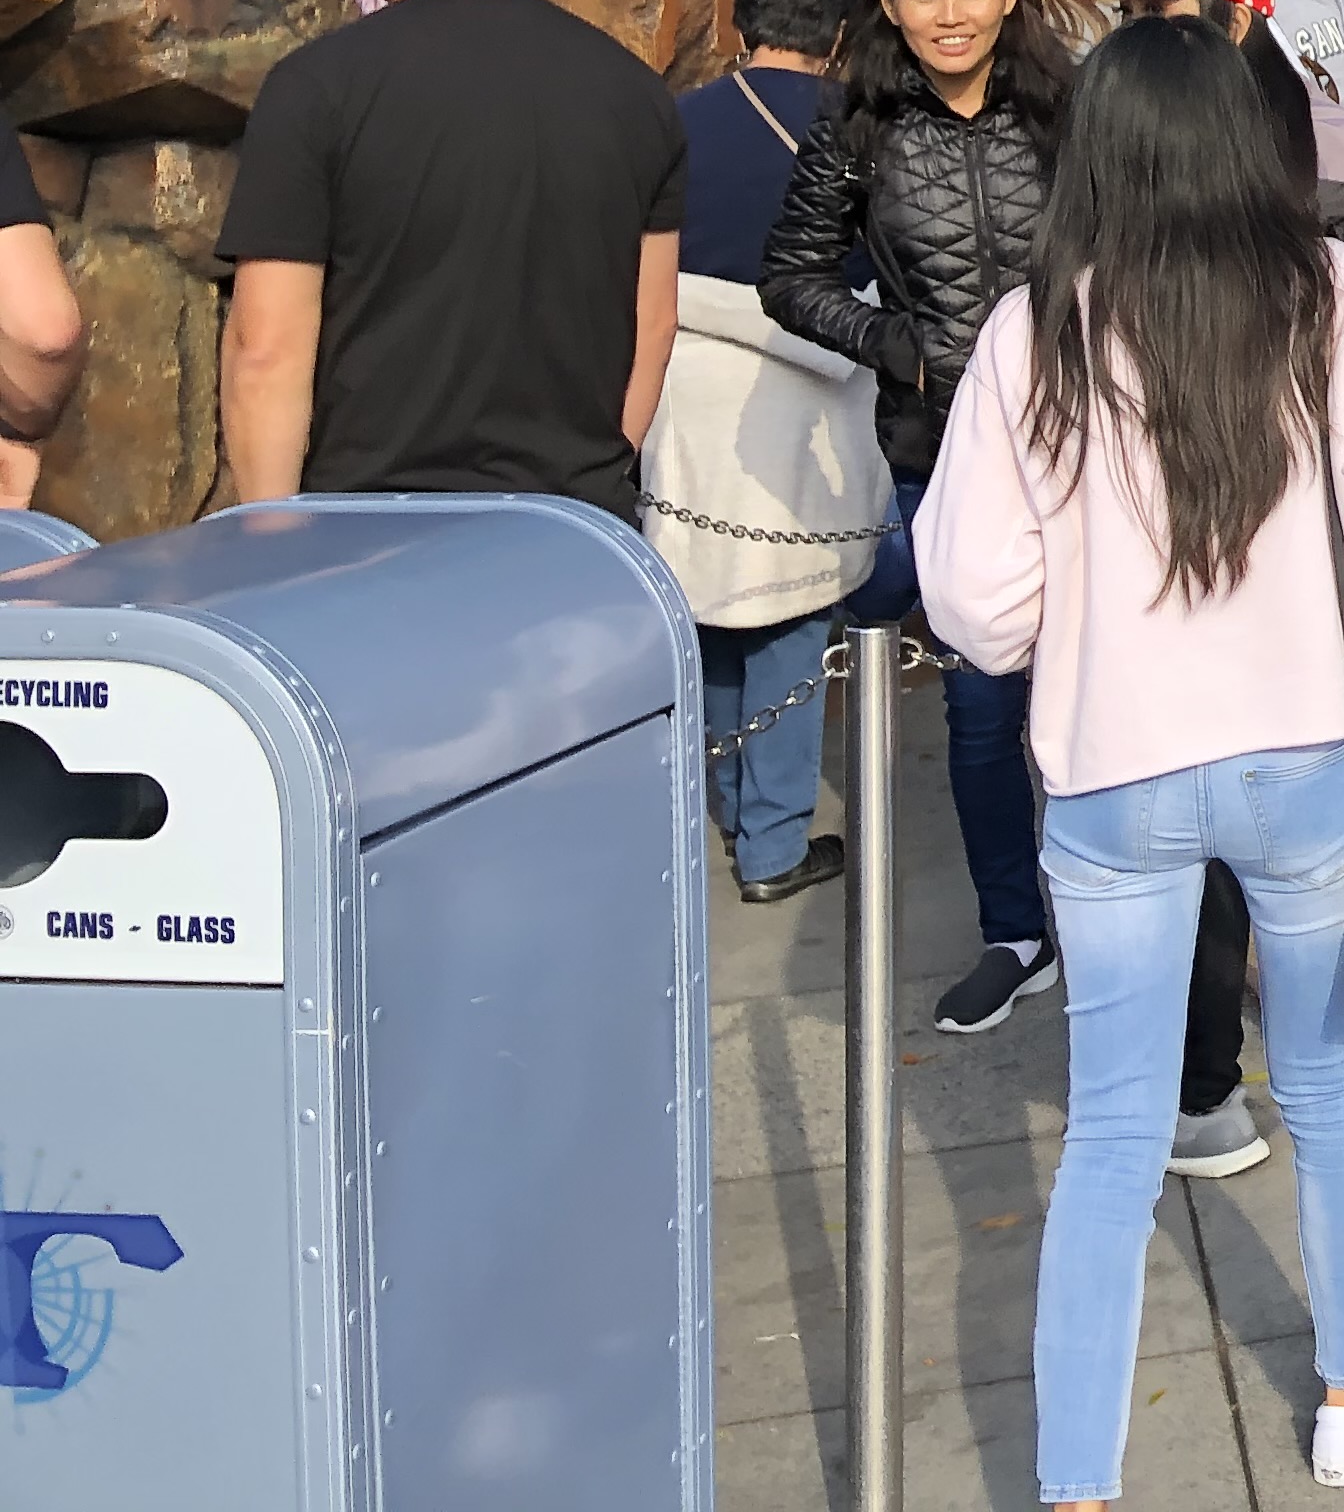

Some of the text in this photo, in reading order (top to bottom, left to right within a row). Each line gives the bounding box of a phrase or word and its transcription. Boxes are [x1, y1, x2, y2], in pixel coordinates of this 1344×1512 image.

[0, 679, 109, 708] CYCLING
[47, 911, 114, 939] CANS
[157, 914, 236, 944] GLASS
